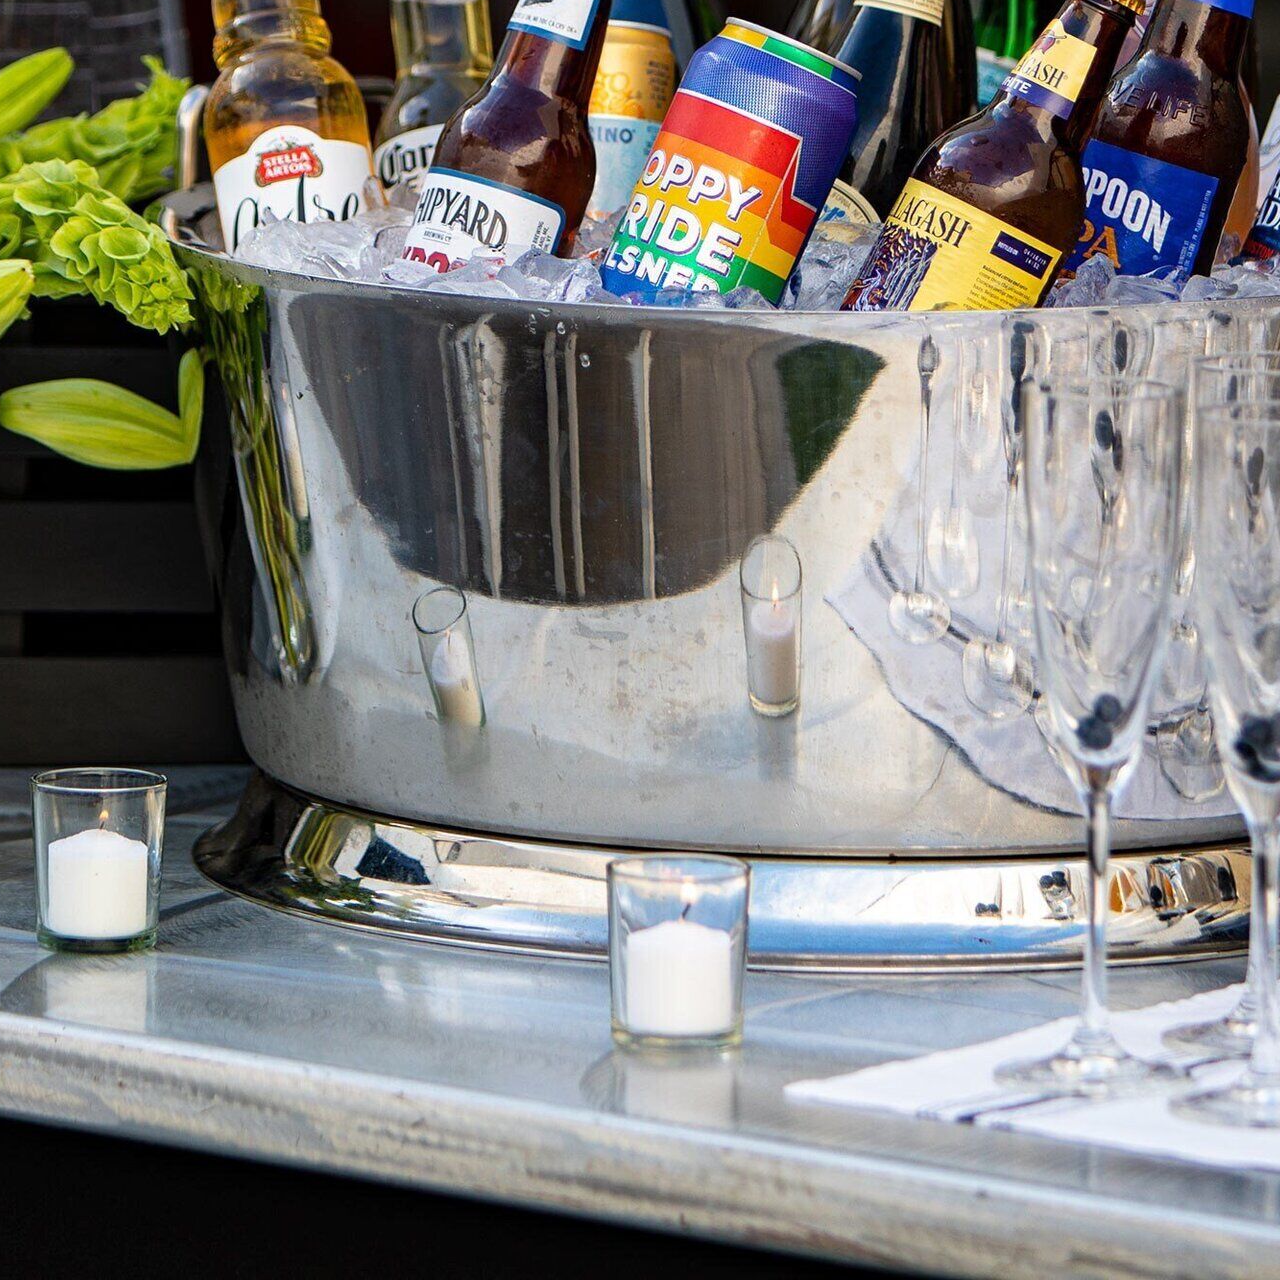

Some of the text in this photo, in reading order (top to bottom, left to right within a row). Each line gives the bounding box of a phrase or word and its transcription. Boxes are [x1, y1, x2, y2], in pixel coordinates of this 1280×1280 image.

[263, 151, 311, 168] STELLA
[265, 162, 313, 180] ARTOIS
[642, 149, 764, 222] OPPY
[417, 187, 509, 252] HIPYARD
[619, 191, 742, 278] RIDE
[892, 192, 971, 249] LAGASH
[1084, 167, 1174, 254] POON
